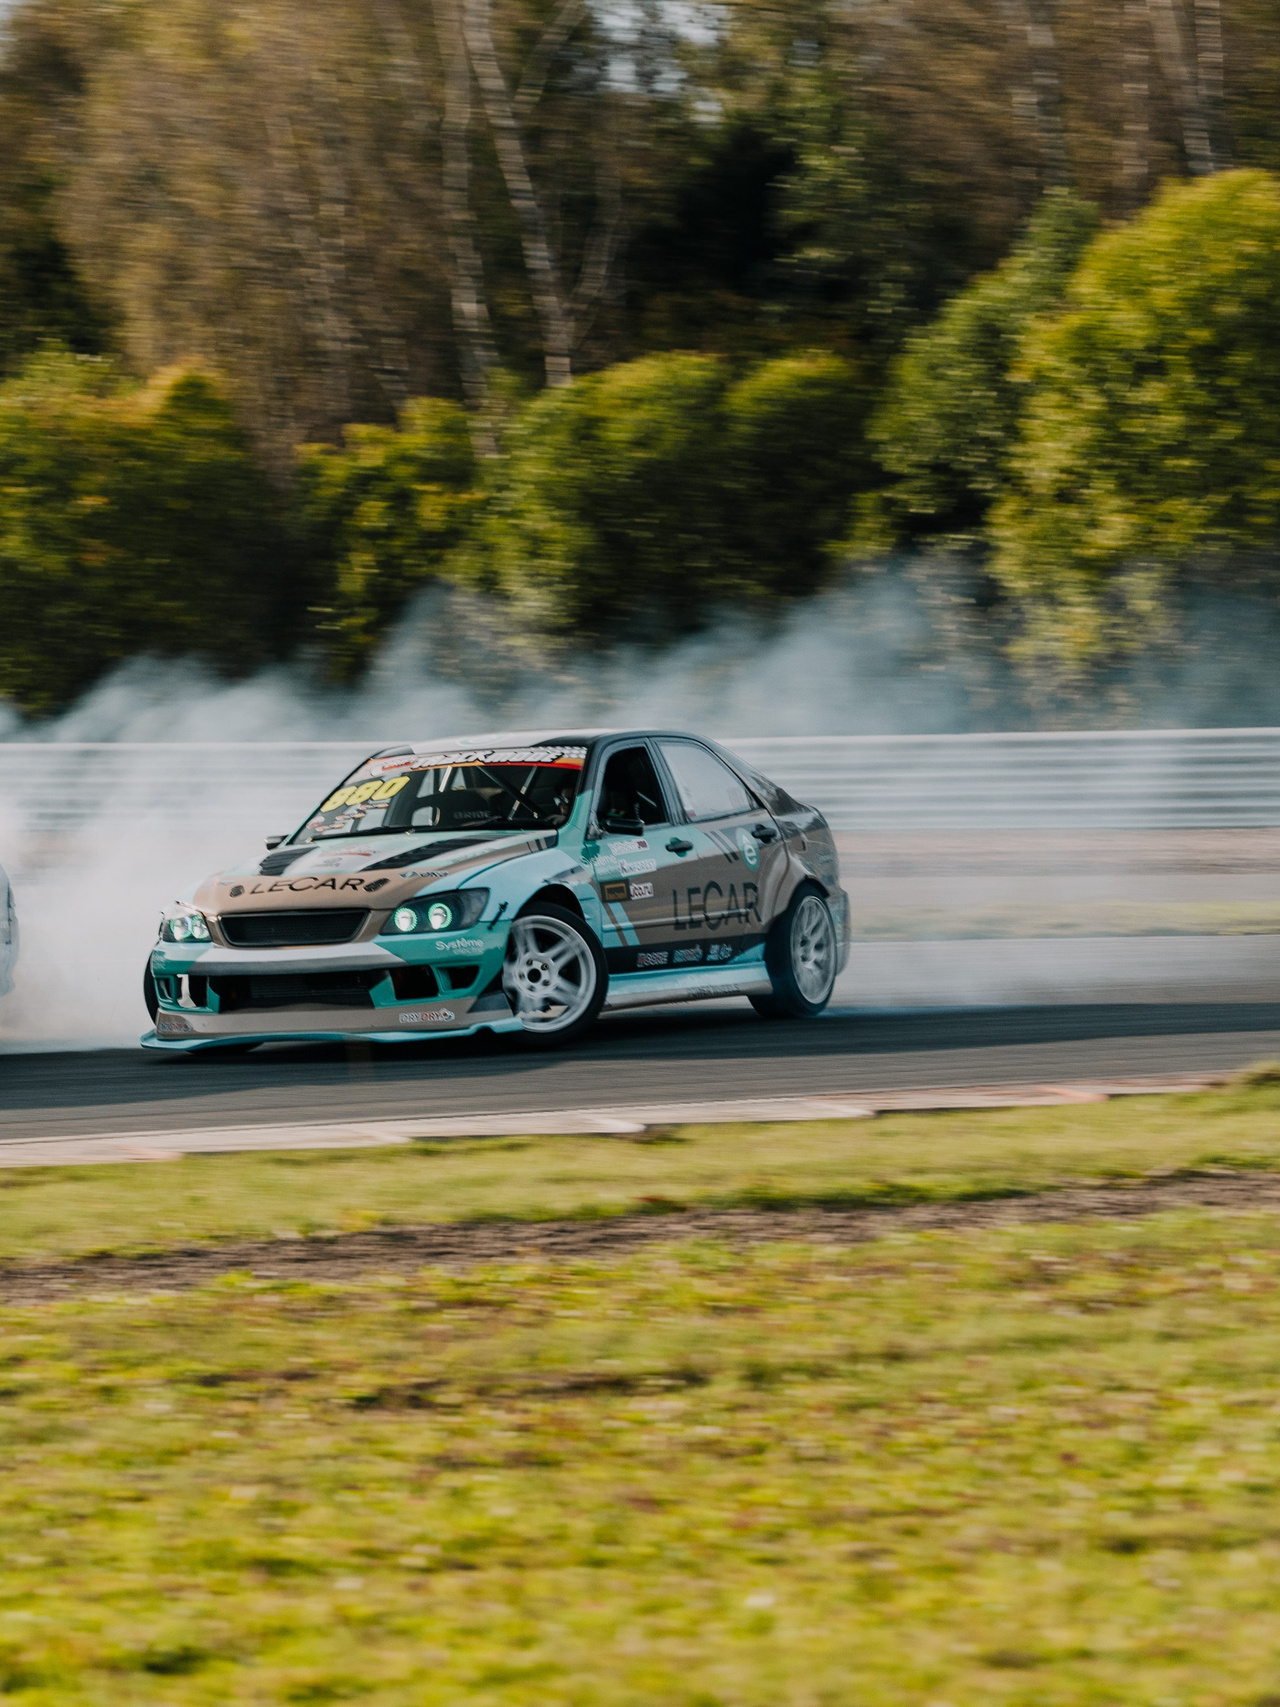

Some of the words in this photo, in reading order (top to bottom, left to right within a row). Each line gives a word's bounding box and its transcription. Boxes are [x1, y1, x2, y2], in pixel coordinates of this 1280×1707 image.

[320, 776, 410, 813] 880
[250, 876, 366, 895] LECAR
[672, 880, 762, 931] LECAR
